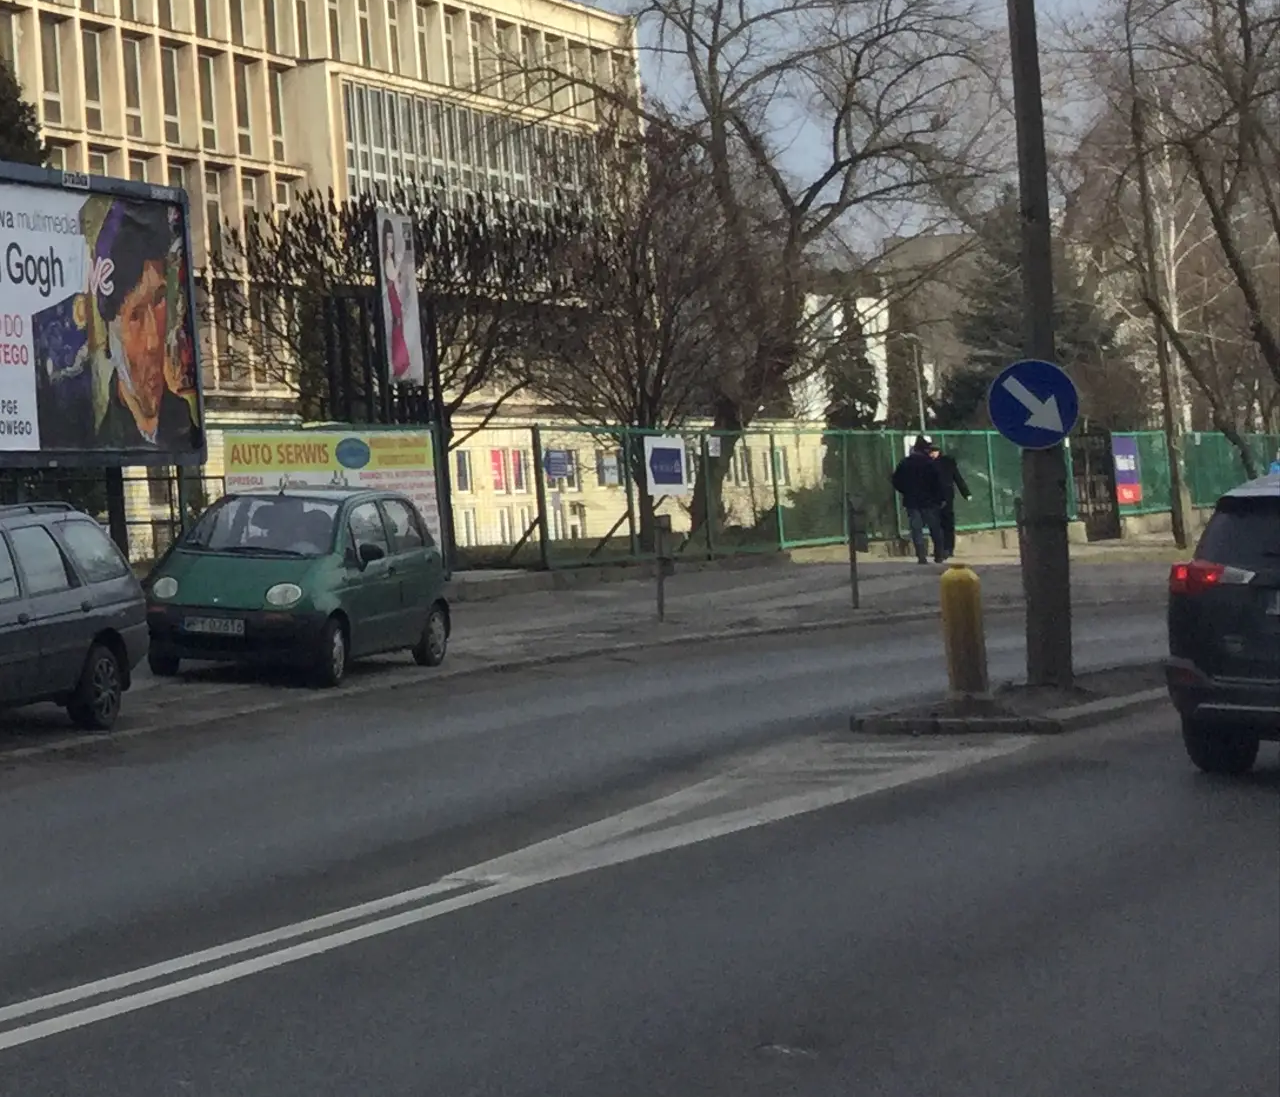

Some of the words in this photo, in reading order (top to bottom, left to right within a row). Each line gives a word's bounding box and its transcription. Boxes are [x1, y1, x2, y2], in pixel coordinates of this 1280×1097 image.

[6, 242, 64, 298] Gogh
[5, 314, 23, 338] DO
[1, 399, 19, 415] PGE
[230, 443, 272, 465] AUTO
[277, 442, 330, 465] SERWIS
